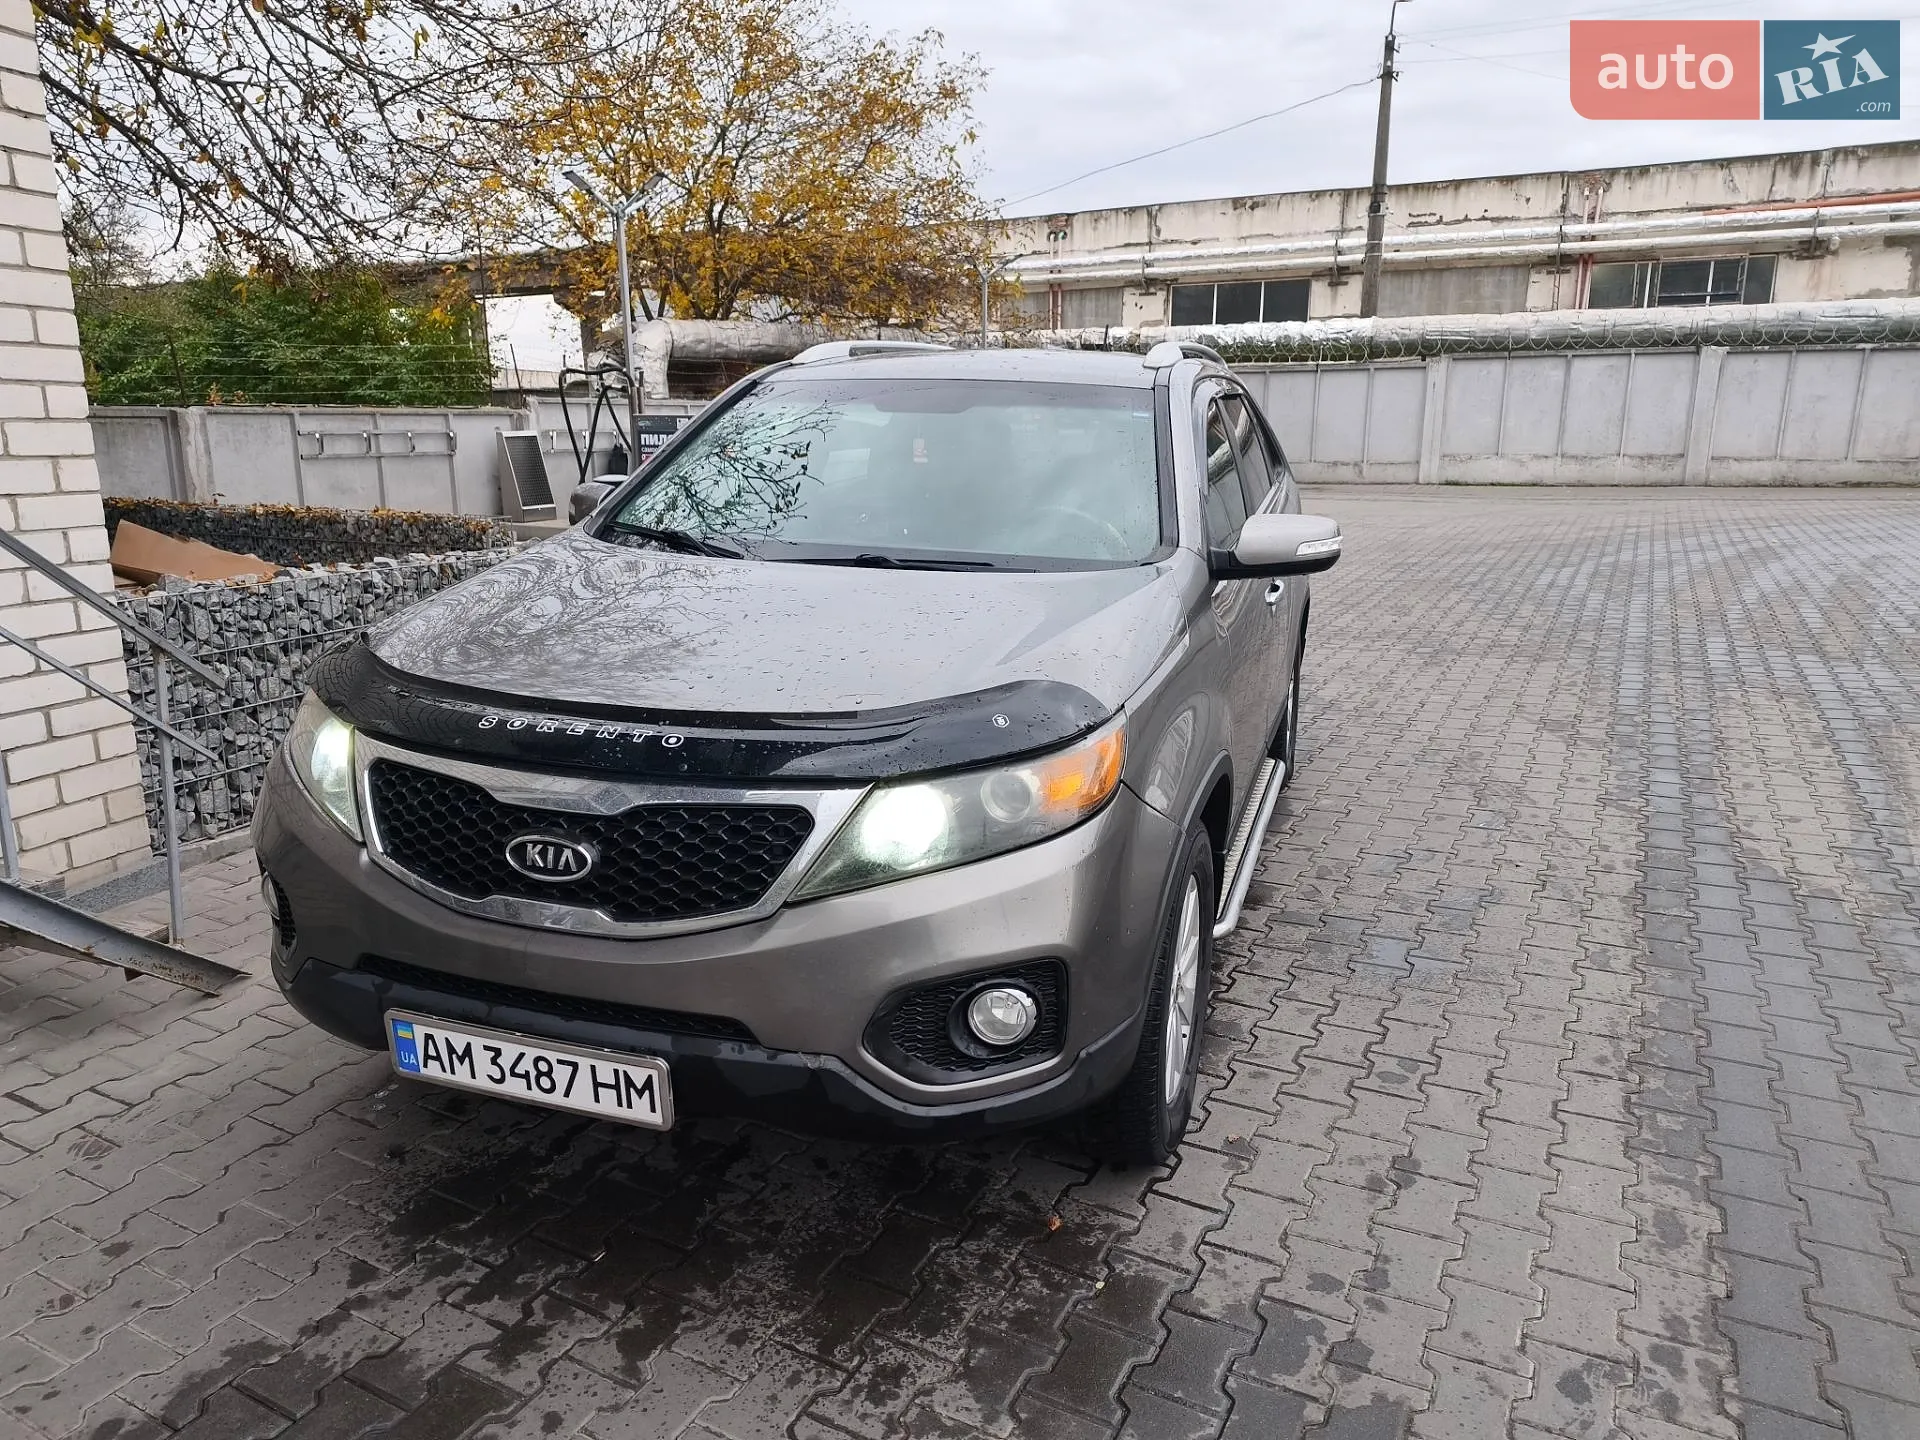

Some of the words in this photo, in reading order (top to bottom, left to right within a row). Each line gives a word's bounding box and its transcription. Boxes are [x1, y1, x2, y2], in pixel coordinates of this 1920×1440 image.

[478, 716, 684, 748] SORENTO
[526, 842, 577, 872] KIA
[400, 1050, 417, 1066] UA
[422, 1032, 477, 1080] AM
[481, 1044, 579, 1099] 3487
[590, 1064, 656, 1114] HM
